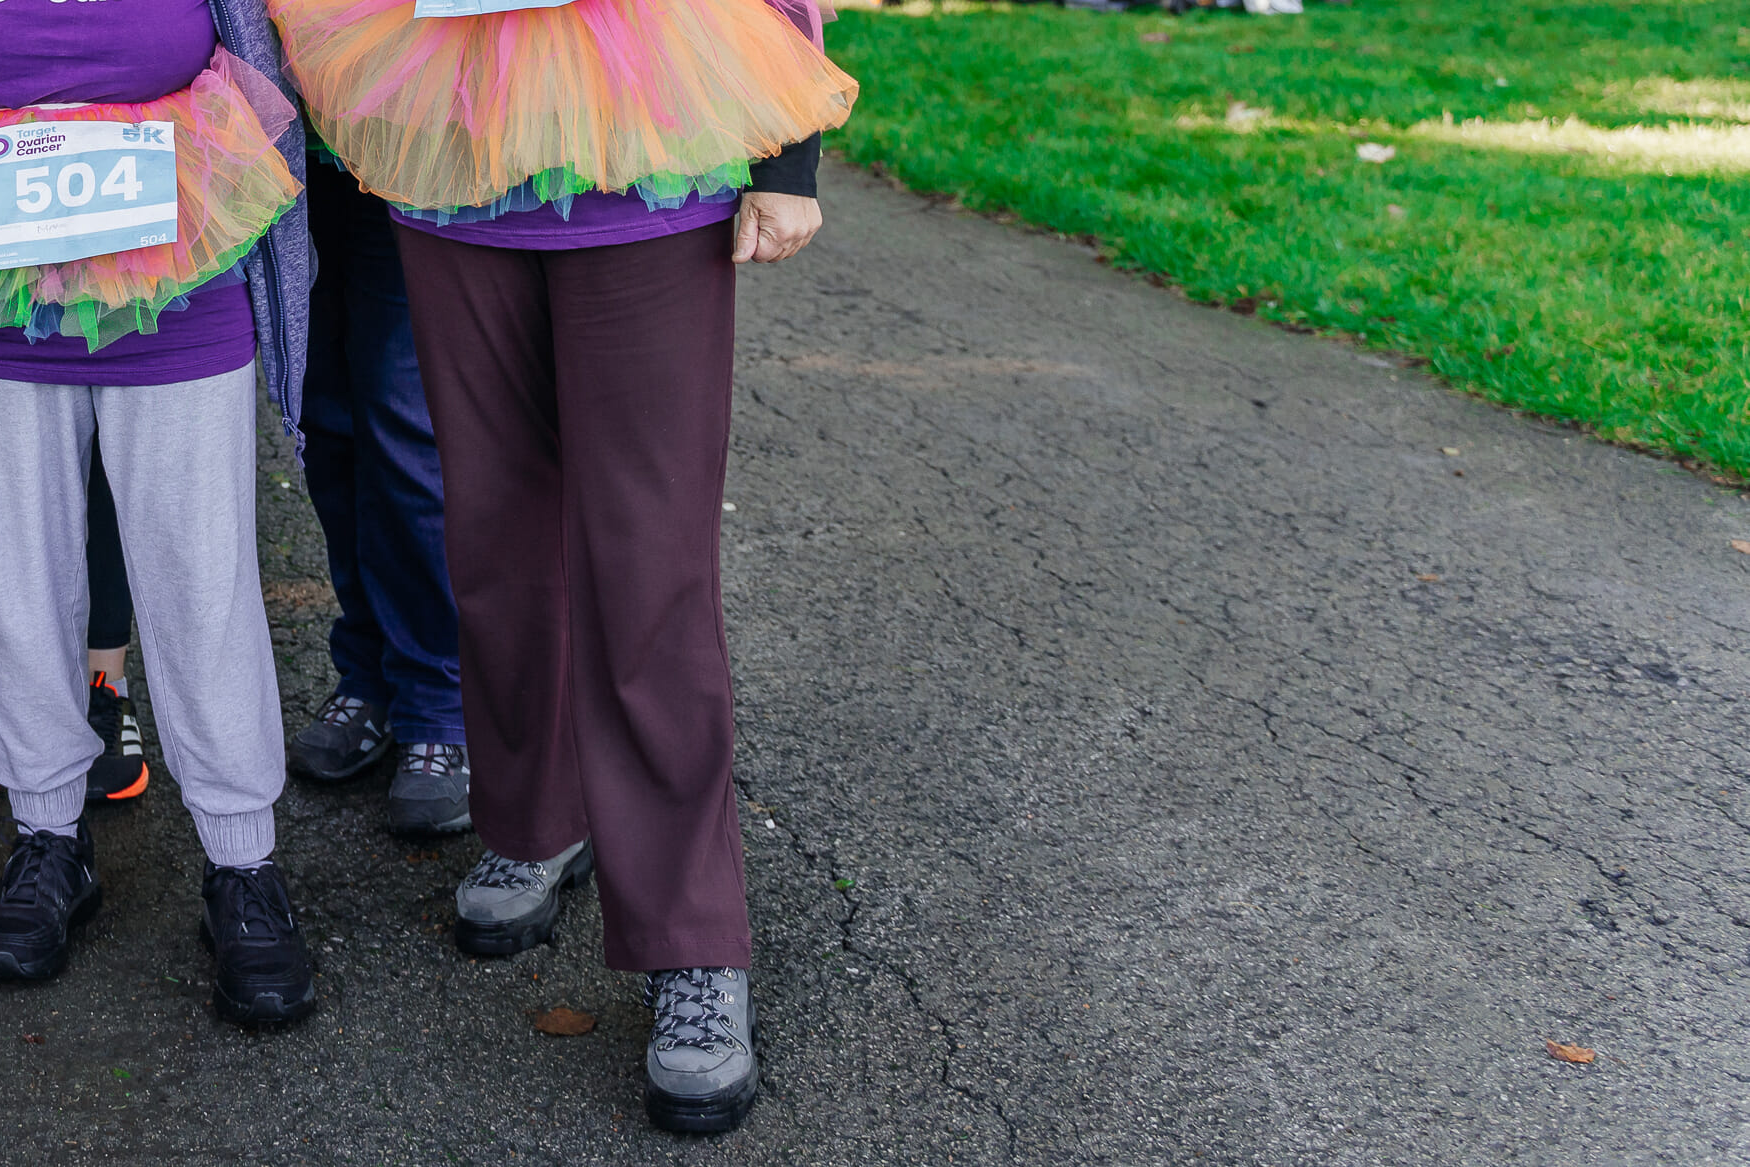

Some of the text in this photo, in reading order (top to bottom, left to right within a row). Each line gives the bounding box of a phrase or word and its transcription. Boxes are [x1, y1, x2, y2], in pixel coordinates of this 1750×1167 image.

[16, 126, 57, 140] Target
[122, 127, 166, 145] 5K
[16, 133, 66, 149] Ovarian
[16, 142, 62, 157] Cancer
[16, 155, 143, 214] 504
[139, 232, 168, 247] 504
